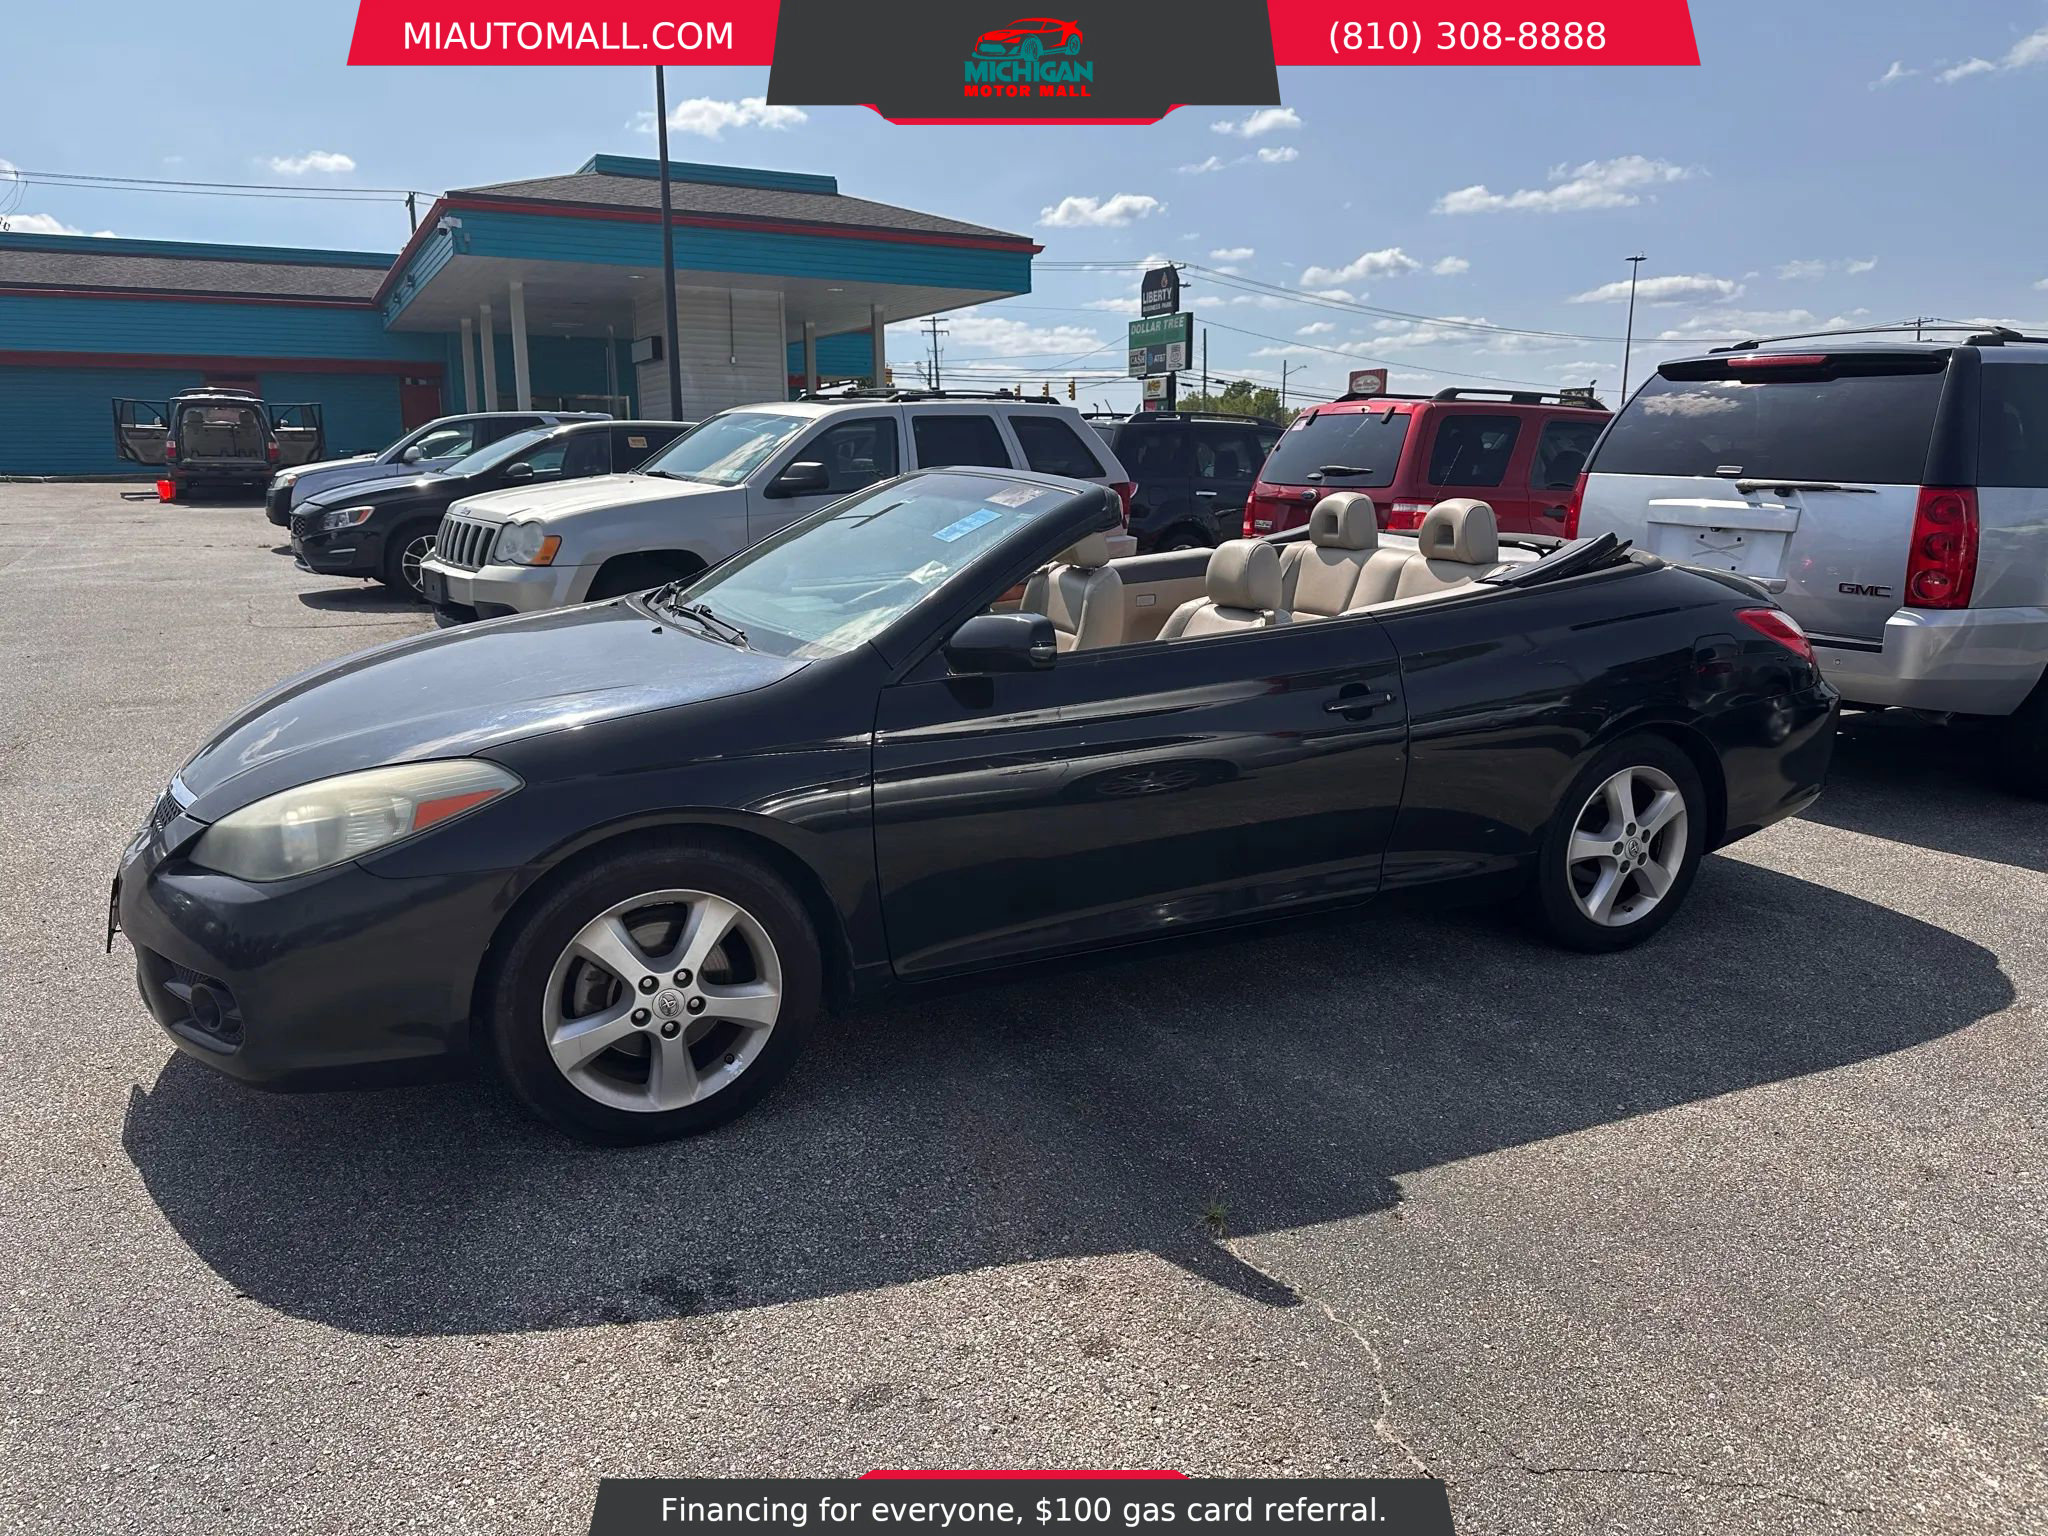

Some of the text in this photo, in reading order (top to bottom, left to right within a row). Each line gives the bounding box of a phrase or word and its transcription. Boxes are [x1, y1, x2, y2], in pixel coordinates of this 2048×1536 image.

[1142, 287, 1173, 304] LIBERTY
[1130, 316, 1185, 335] DOLLAR TREE
[1838, 582, 1892, 598] GMC
